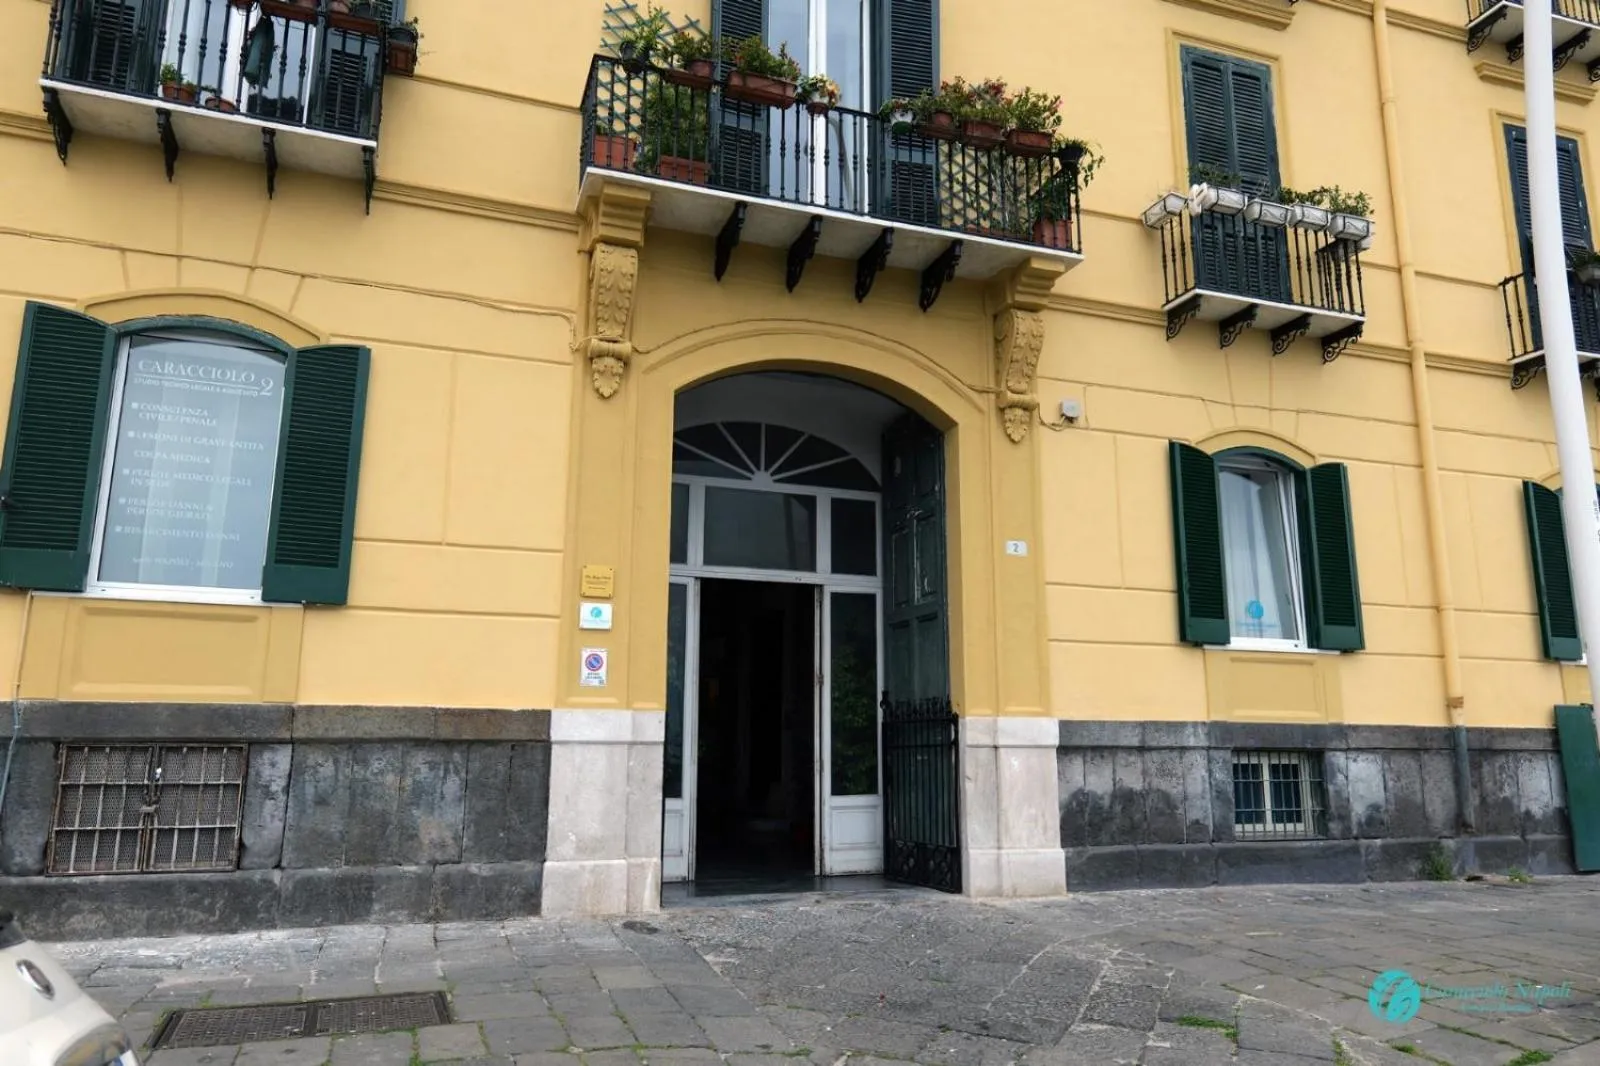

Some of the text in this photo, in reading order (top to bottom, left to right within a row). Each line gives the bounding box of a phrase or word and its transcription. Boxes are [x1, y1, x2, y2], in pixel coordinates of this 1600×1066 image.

[138, 360, 274, 396] CARACCIOLO 2
[140, 403, 208, 416] CONSULENZA
[136, 431, 178, 443] LESIONI
[193, 435, 225, 447] GRAVE
[168, 453, 211, 464] MEDICA
